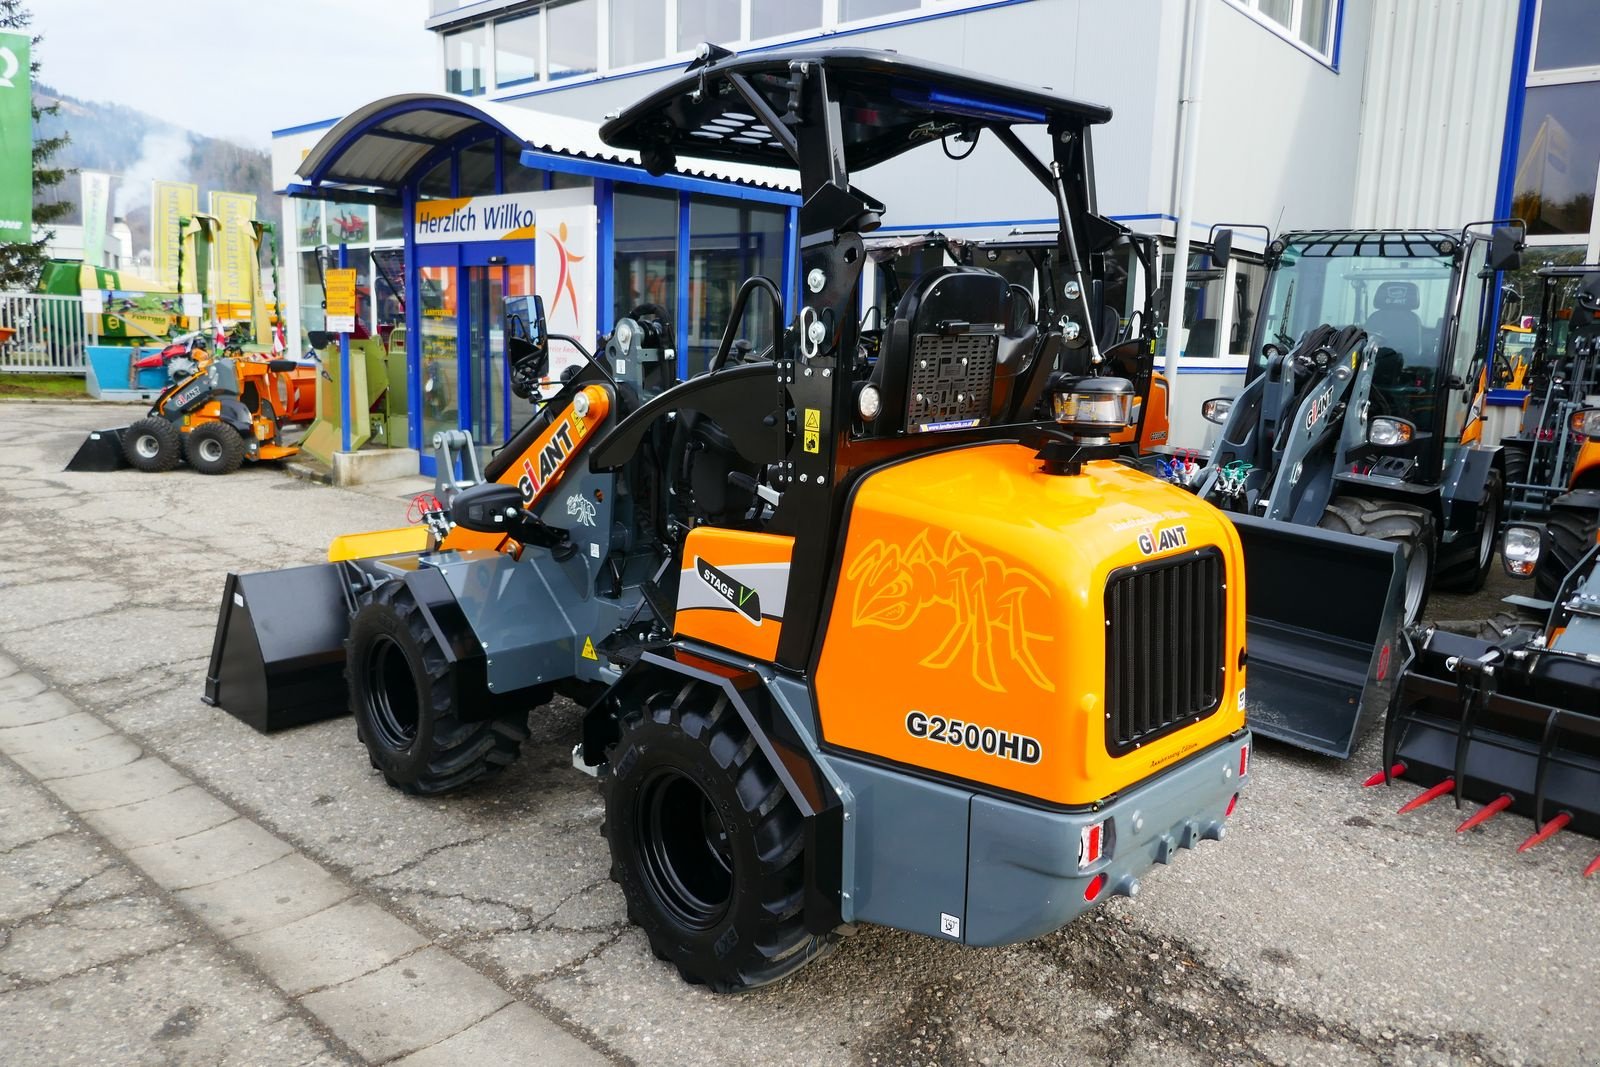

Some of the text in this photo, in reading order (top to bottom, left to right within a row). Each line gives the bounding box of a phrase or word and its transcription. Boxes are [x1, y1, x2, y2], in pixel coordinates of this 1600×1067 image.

[419, 202, 536, 235] Herzlich Willko
[703, 569, 757, 607] STAGE V
[905, 710, 1042, 765] G2500HD
